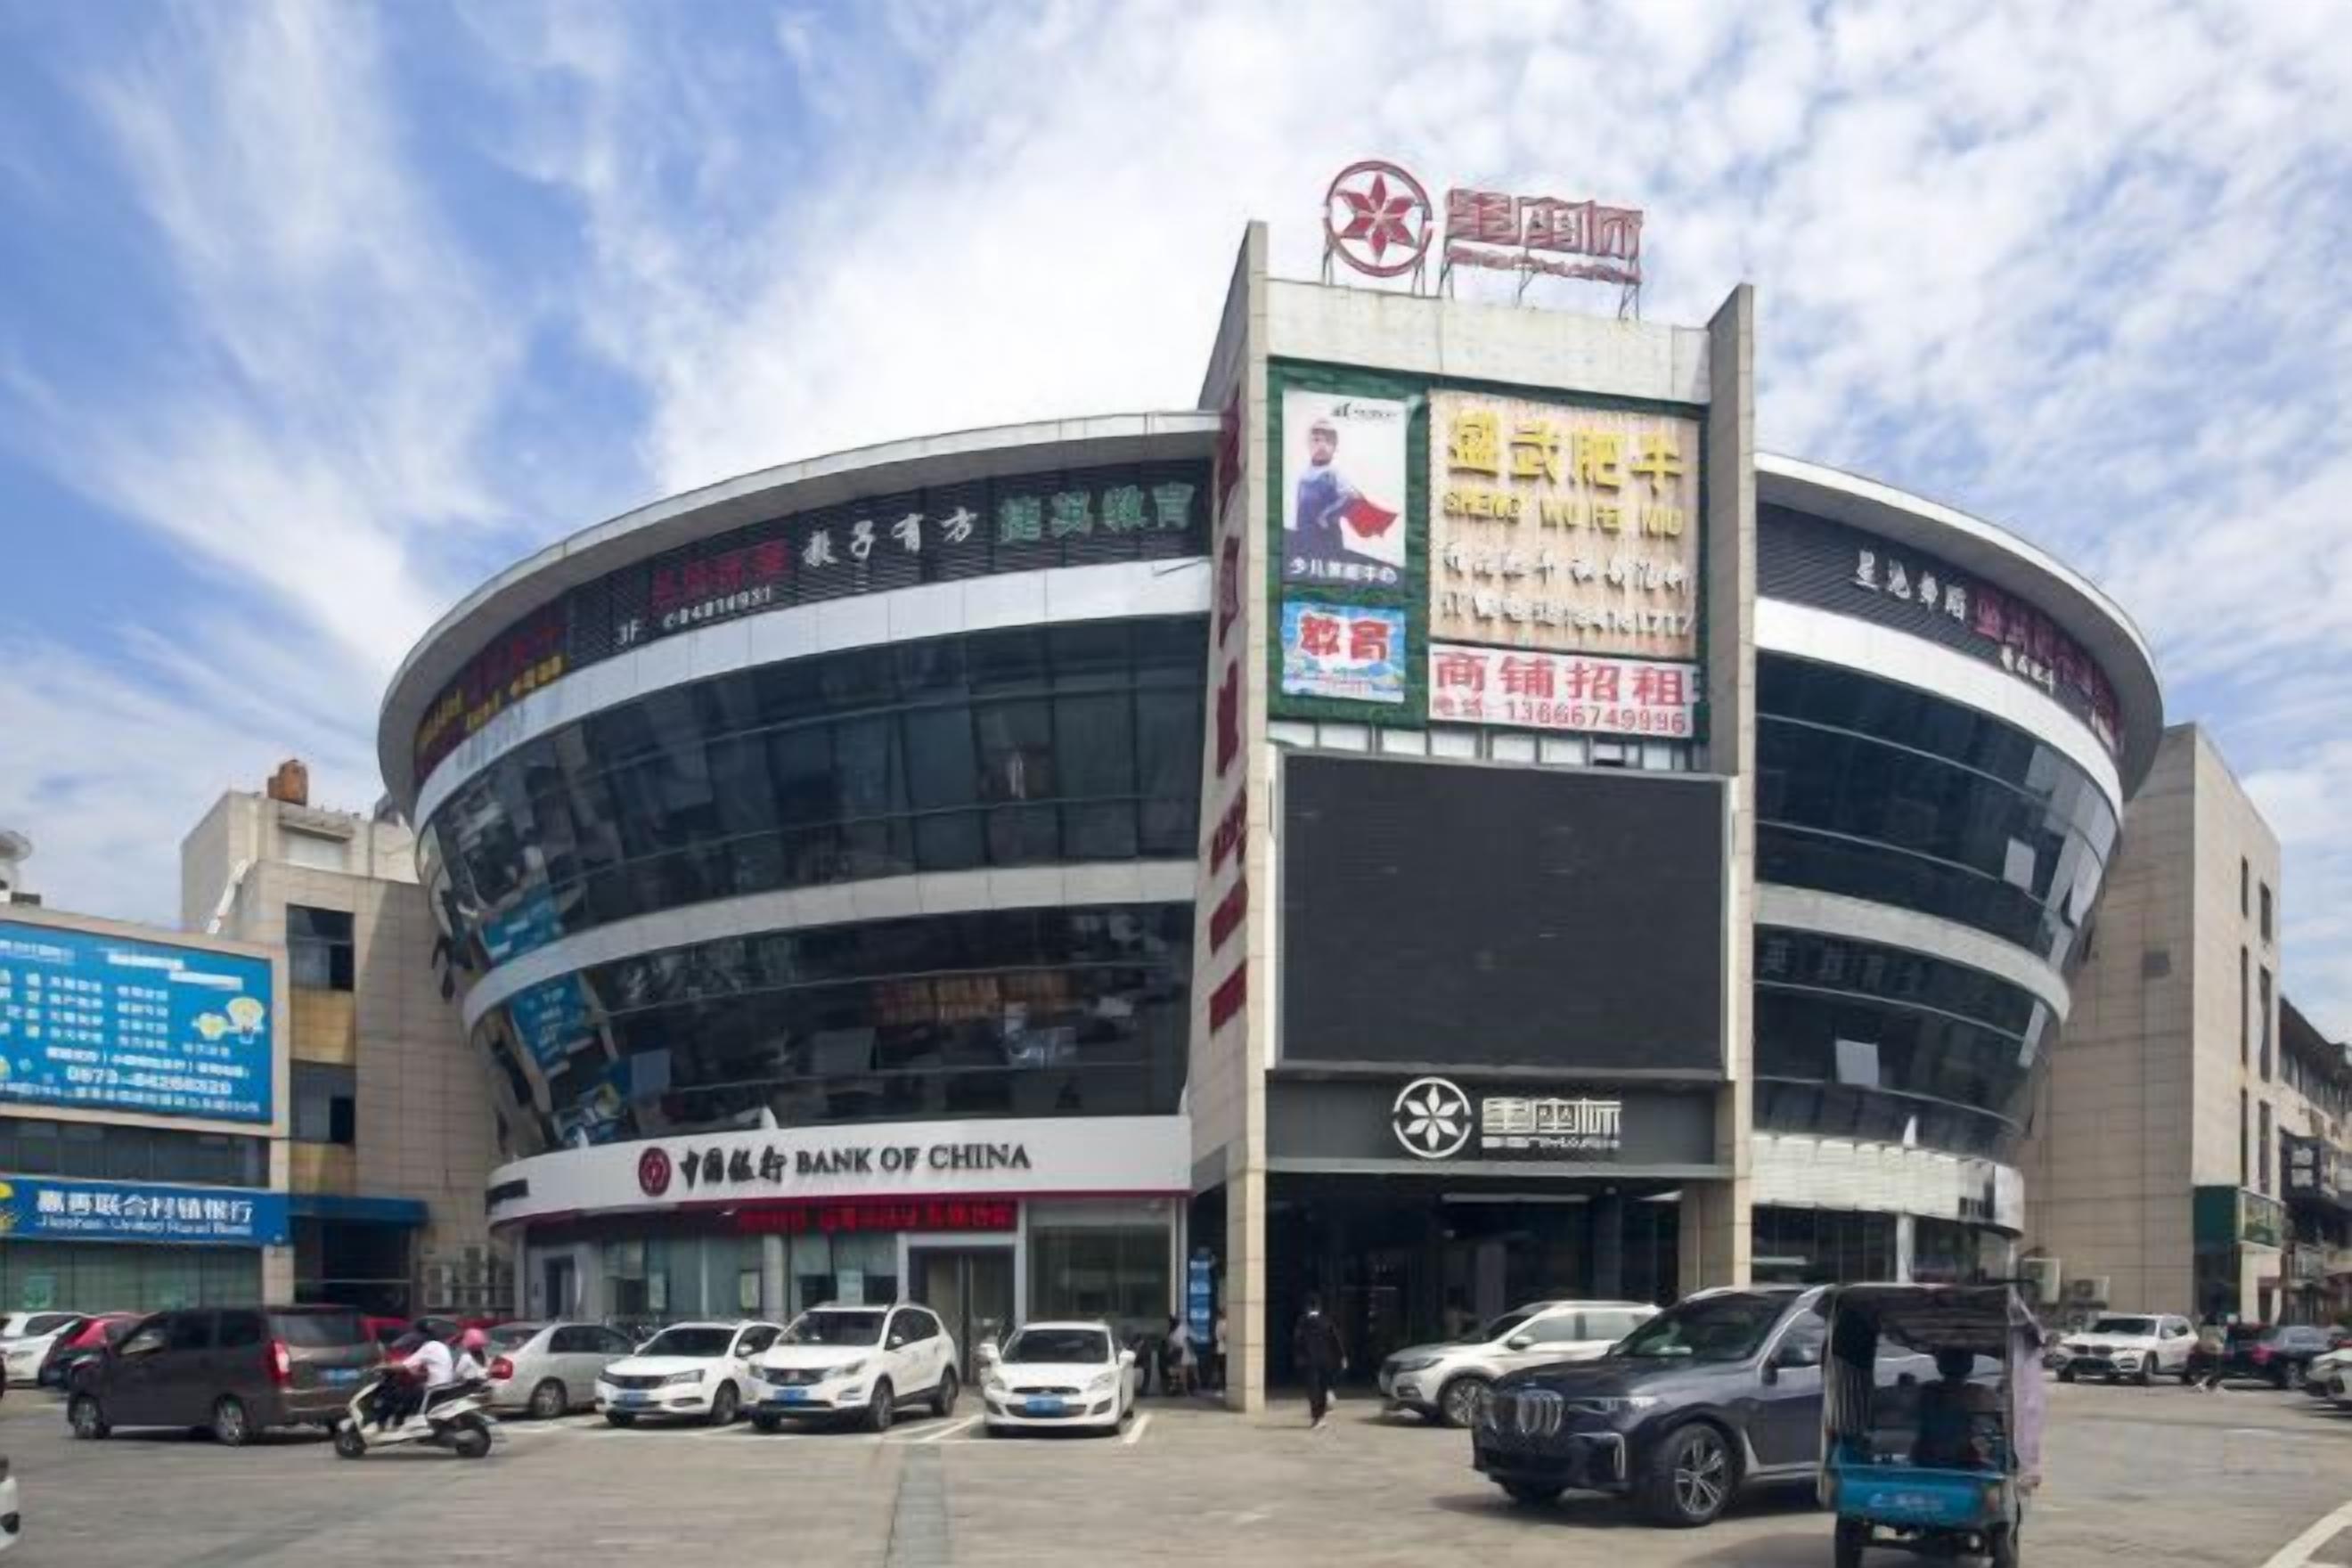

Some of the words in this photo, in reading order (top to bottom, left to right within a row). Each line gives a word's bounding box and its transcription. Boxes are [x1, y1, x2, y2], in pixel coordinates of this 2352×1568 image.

[1433, 651, 1686, 706] 商铺招租
[680, 1145, 787, 1189] 中国银行
[796, 1150, 872, 1175] BANK
[880, 1147, 921, 1172] OF
[928, 1143, 1032, 1171] CHINA
